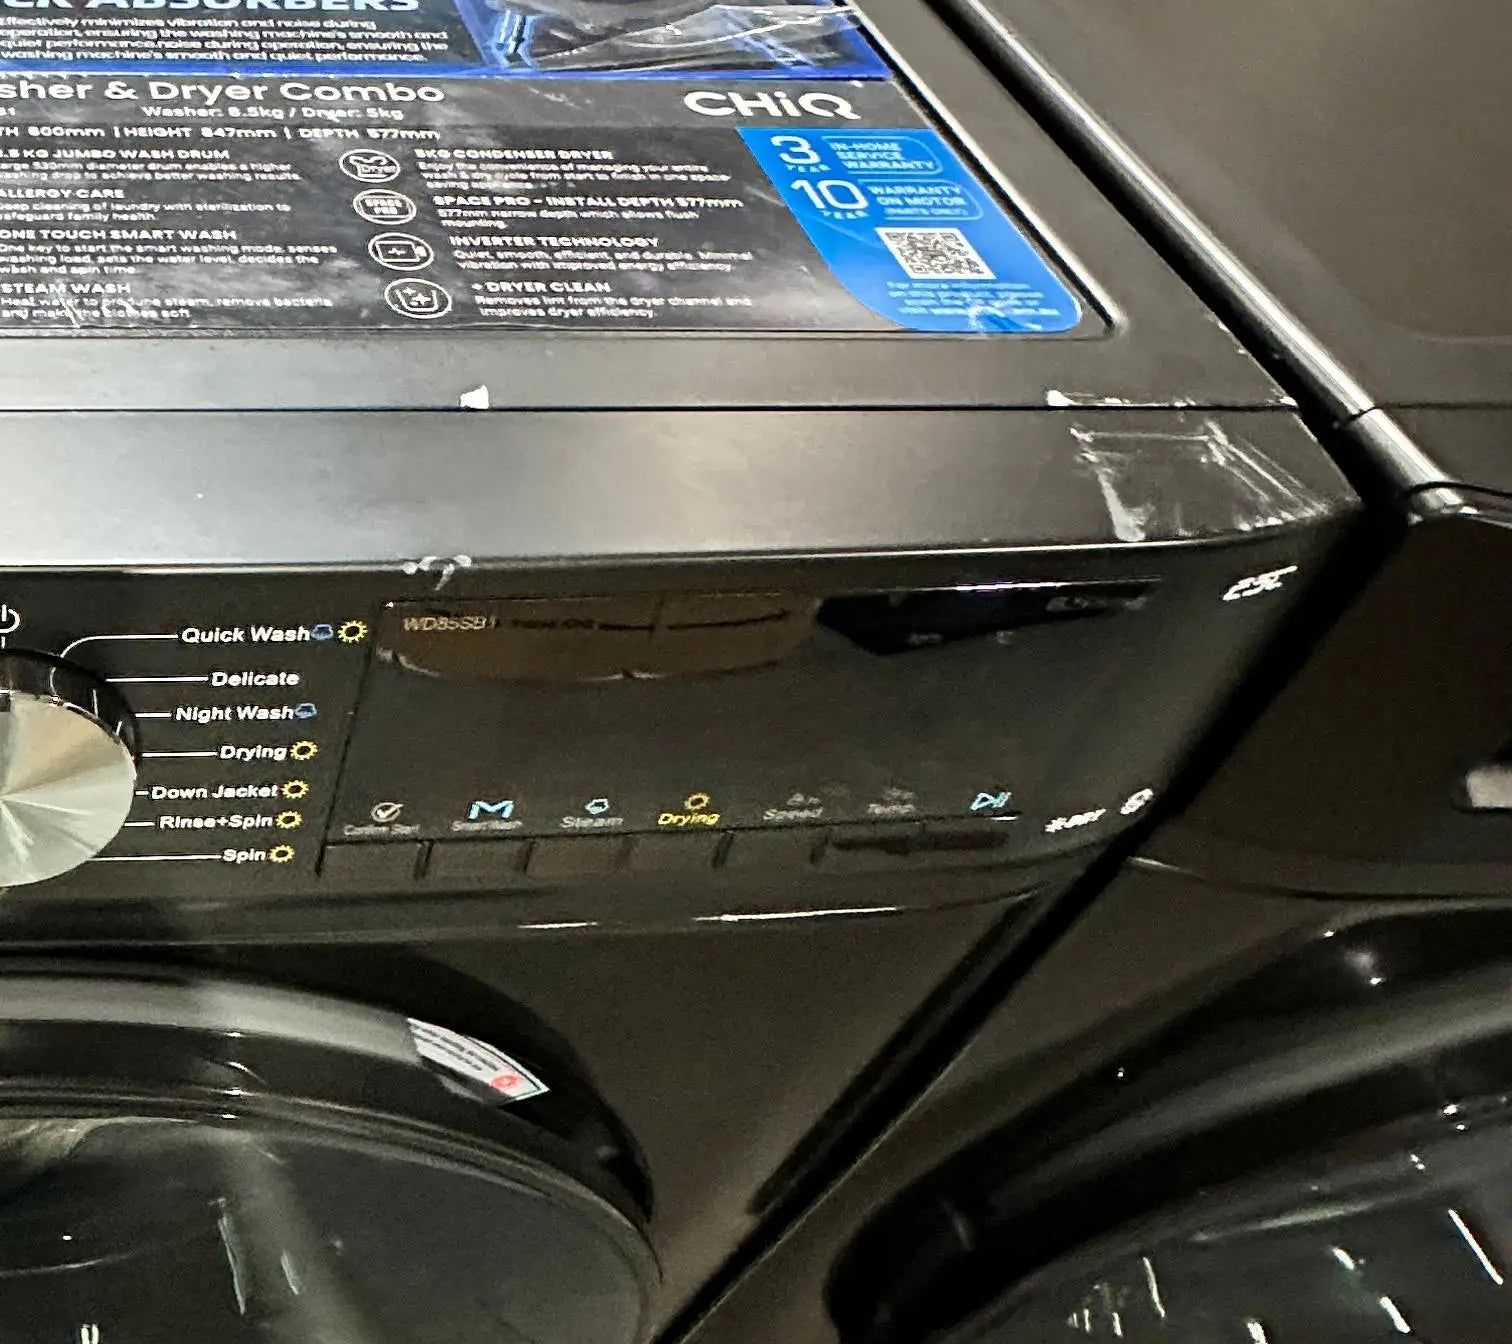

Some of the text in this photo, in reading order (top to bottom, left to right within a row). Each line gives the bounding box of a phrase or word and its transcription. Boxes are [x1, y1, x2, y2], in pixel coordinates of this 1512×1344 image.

[81, 18, 164, 27] minimizes
[167, 18, 238, 27] vibration
[241, 19, 275, 27] and
[277, 20, 320, 28] noise
[323, 20, 376, 30] during
[0, 28, 448, 40] operation, ensuring the washing machine's smooth and
[0, 39, 42, 48] quiet
[204, 41, 259, 51] during
[347, 42, 419, 51] ensuring
[421, 42, 448, 50] the
[1, 51, 73, 60] washing
[76, 51, 162, 59] machine's
[165, 51, 230, 60] smooth
[233, 52, 267, 60] and
[270, 52, 312, 62] quiet
[104, 81, 138, 99] &
[148, 81, 268, 105] Dryer
[280, 83, 444, 101] Combo
[684, 91, 861, 119] CHiQ
[143, 107, 224, 118] Washer:
[366, 108, 403, 120] 5kg
[124, 127, 192, 137] HEIGHT
[201, 128, 277, 138] 847mm
[300, 129, 358, 139] DEPTH
[770, 135, 821, 164] 3
[831, 142, 902, 151] IN-HOME
[23, 149, 49, 158] KG
[52, 149, 116, 158] JUMBO
[120, 150, 174, 159] WASH
[177, 150, 230, 159] DRUM
[454, 150, 556, 159] CONDENSER
[560, 150, 613, 160] DRYER
[836, 152, 905, 160] SERVICE
[86, 162, 144, 170] diameter
[251, 163, 291, 172] higher
[786, 164, 831, 173] YEAR
[843, 160, 935, 169] WARRANTY
[101, 172, 152, 180] achieve
[196, 173, 252, 182] washing
[76, 189, 125, 199] CARE
[791, 179, 869, 210] 10
[868, 186, 961, 195] WARRANTY
[433, 196, 491, 205] SPACE
[493, 196, 531, 205] PRO
[546, 197, 616, 206] INSTALL
[617, 197, 675, 206] DEPTH
[876, 197, 967, 206] ON MOTOR
[33, 202, 90, 213] cleaning
[110, 202, 160, 213] laundry
[164, 203, 192, 211] with
[68, 212, 109, 222] family
[39, 230, 106, 239] TOUCH
[109, 230, 174, 240] SMART
[177, 230, 237, 240] WASH
[449, 236, 659, 247] INVERTER TECHNOLOGY
[29, 244, 53, 254] key
[74, 245, 106, 253] start
[136, 245, 176, 253] smart
[180, 245, 238, 254] washing
[131, 255, 153, 263] the
[238, 255, 292, 264] decides
[296, 256, 319, 264] the
[40, 265, 67, 274] and
[70, 265, 100, 275] spin
[1, 283, 131, 294] STEAM WASH
[485, 282, 611, 292] DRYER CLEAN
[1, 297, 333, 307] Heat remove bacteria
[2, 309, 28, 318] and
[181, 627, 311, 644] Quick Wash
[211, 672, 300, 686] Delicate
[176, 706, 294, 723] Night Wash
[220, 745, 287, 761] Drying
[151, 784, 279, 799] Down Jacket
[159, 814, 273, 831] Rinse+Spin
[657, 810, 720, 827] Drying
[223, 849, 267, 864] Spin
